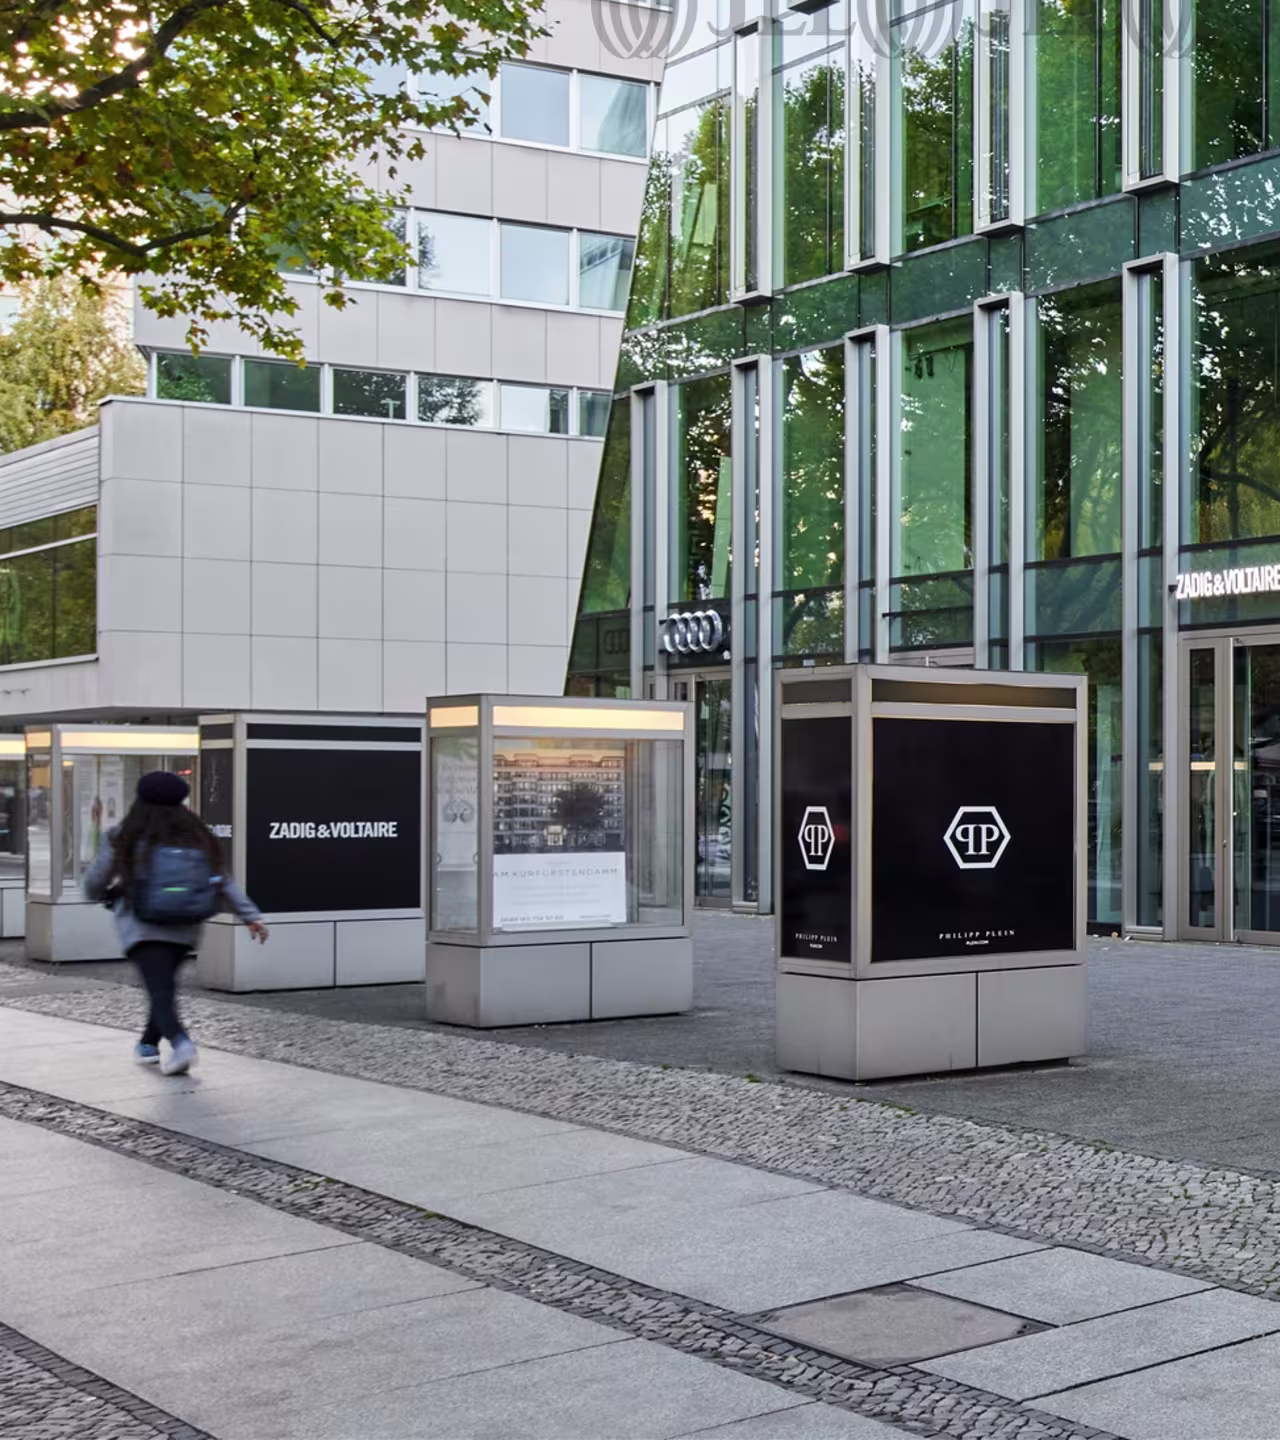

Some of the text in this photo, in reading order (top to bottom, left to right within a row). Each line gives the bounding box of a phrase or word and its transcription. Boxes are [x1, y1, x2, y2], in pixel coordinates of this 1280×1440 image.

[269, 821, 398, 839] ZADIG&VOLTAIRE
[938, 929, 1015, 940] PHILIPP PLEIN
